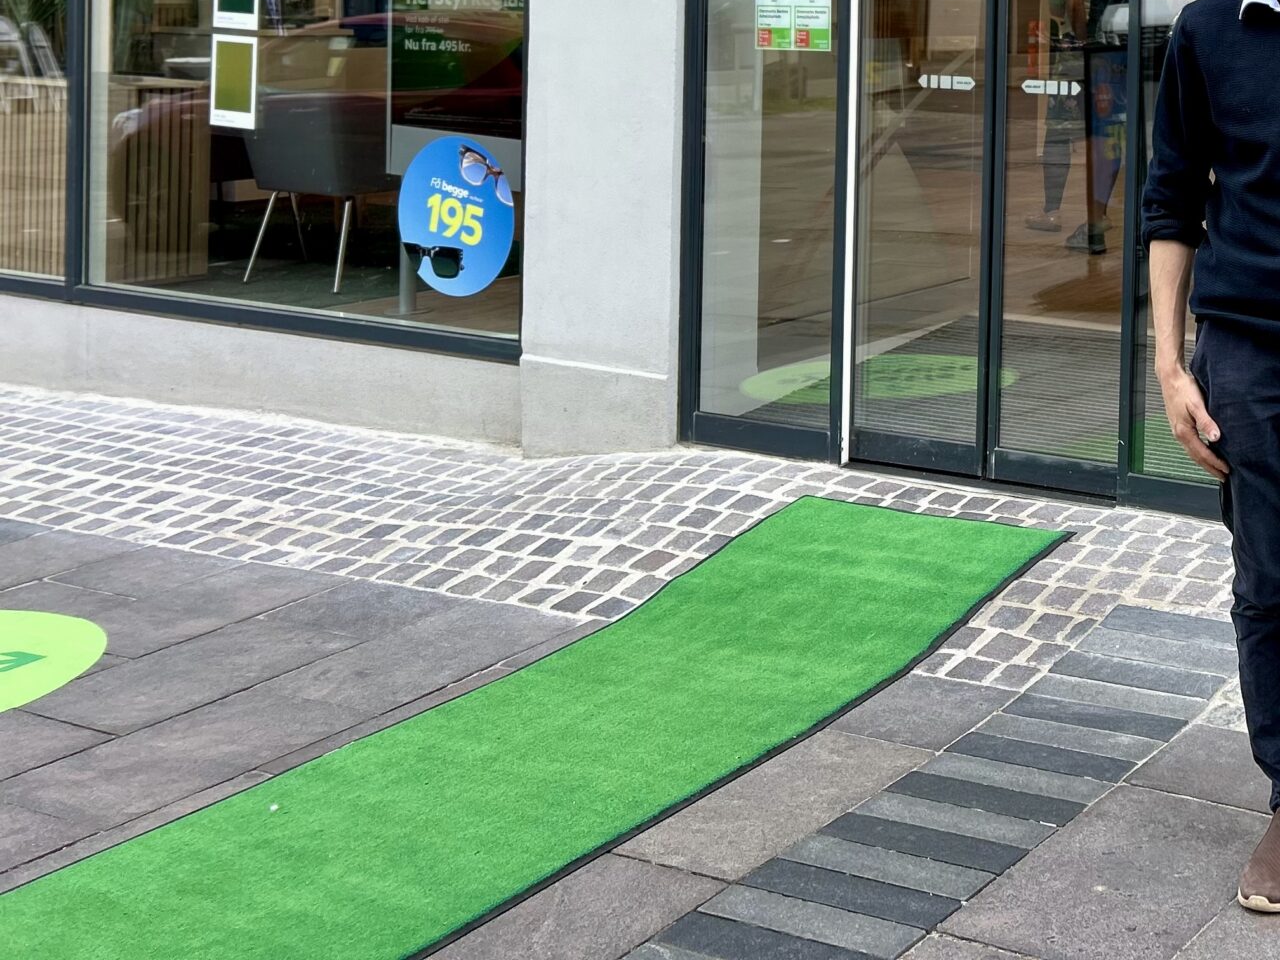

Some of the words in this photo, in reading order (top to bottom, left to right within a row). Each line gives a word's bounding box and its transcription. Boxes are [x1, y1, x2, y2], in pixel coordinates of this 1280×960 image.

[404, 39, 419, 50] Nu
[421, 38, 436, 51] fra
[430, 177, 441, 189] Få
[442, 180, 469, 199] begge
[427, 193, 484, 246] 195
